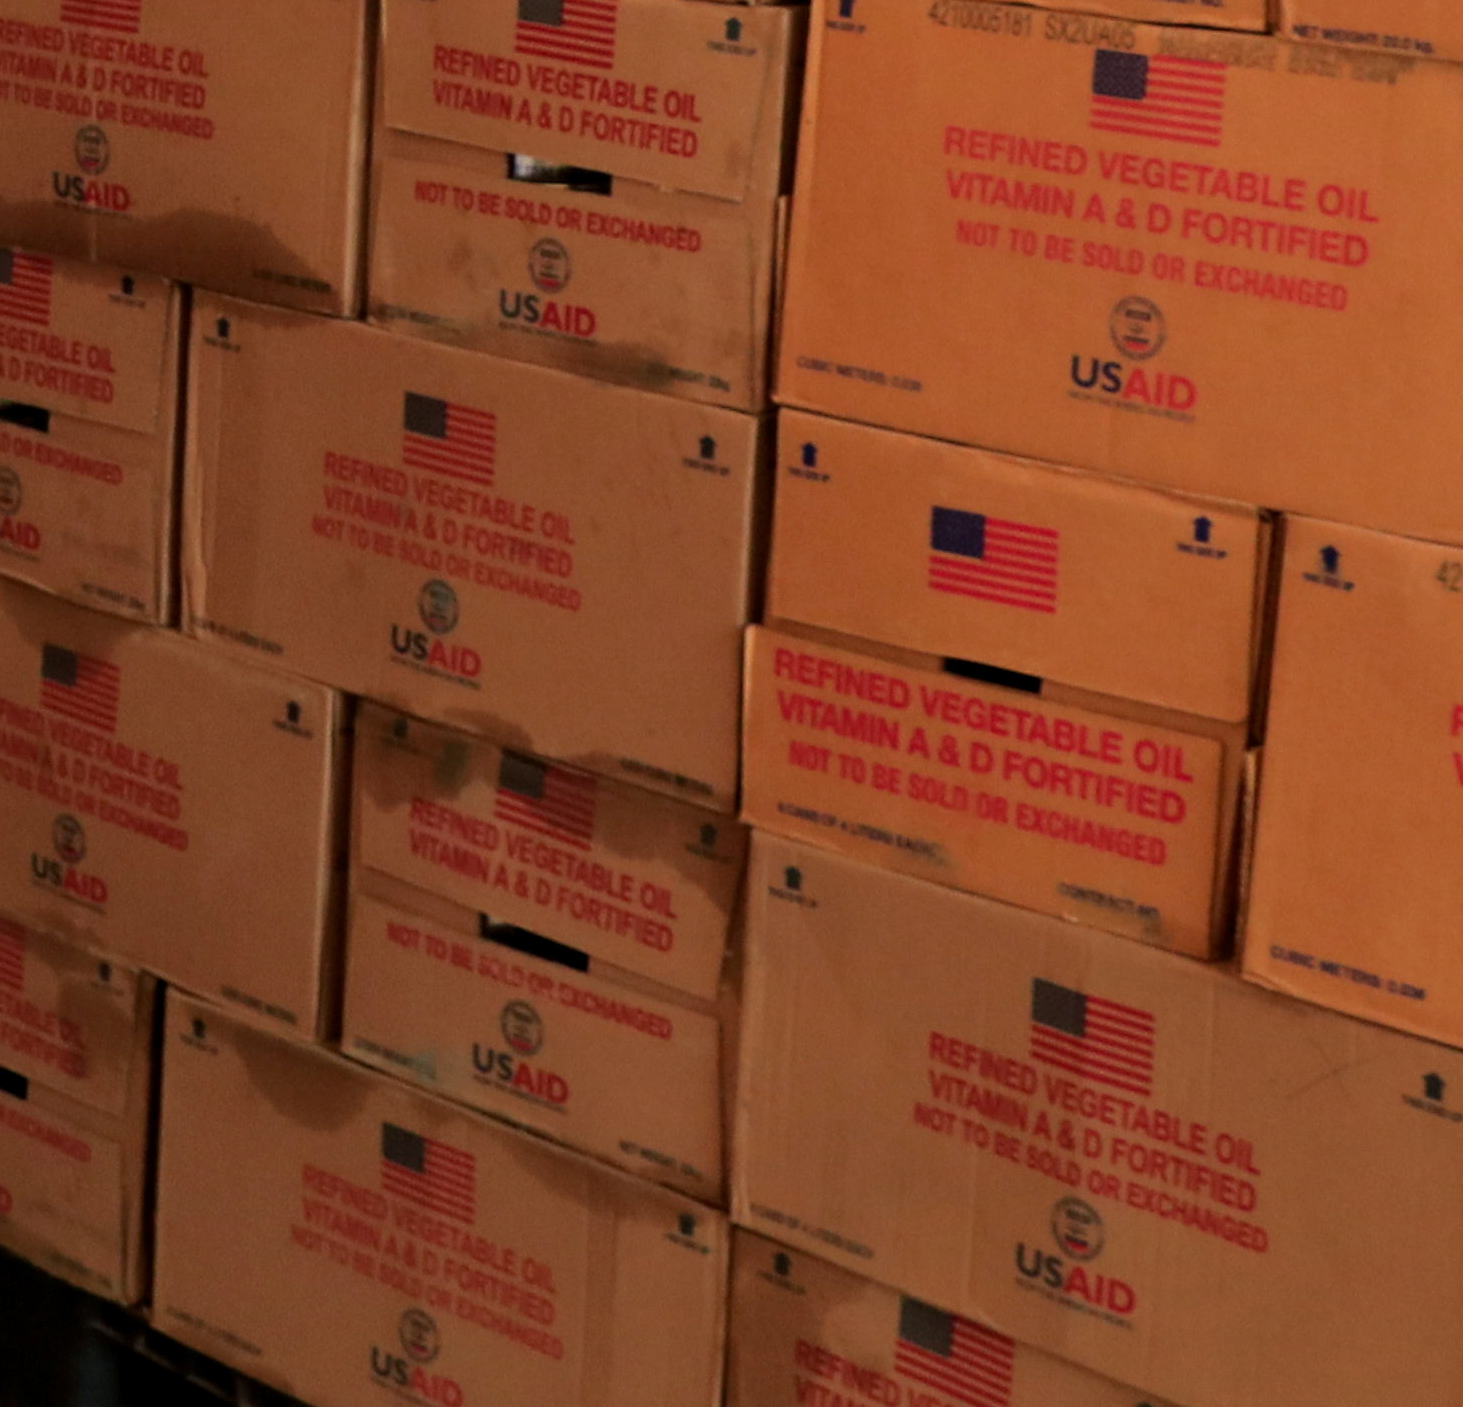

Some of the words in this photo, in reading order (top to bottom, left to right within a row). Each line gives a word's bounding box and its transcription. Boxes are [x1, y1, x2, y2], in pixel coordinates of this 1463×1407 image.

[500, 290, 596, 339] USAID
[1071, 356, 1197, 411] USAID
[473, 1044, 569, 1106] USAID
[930, 1031, 1037, 1096] REFINED
[1045, 1073, 1207, 1157] VEGETABLE
[1215, 1130, 1260, 1176] OIL
[930, 1071, 1028, 1137] VITAMIN
[1033, 1109, 1050, 1140] A
[1057, 1119, 1076, 1153] &
[1083, 1126, 1103, 1161] D
[1111, 1135, 1256, 1214] FORTIFIED
[1017, 1244, 1136, 1314] USAID
